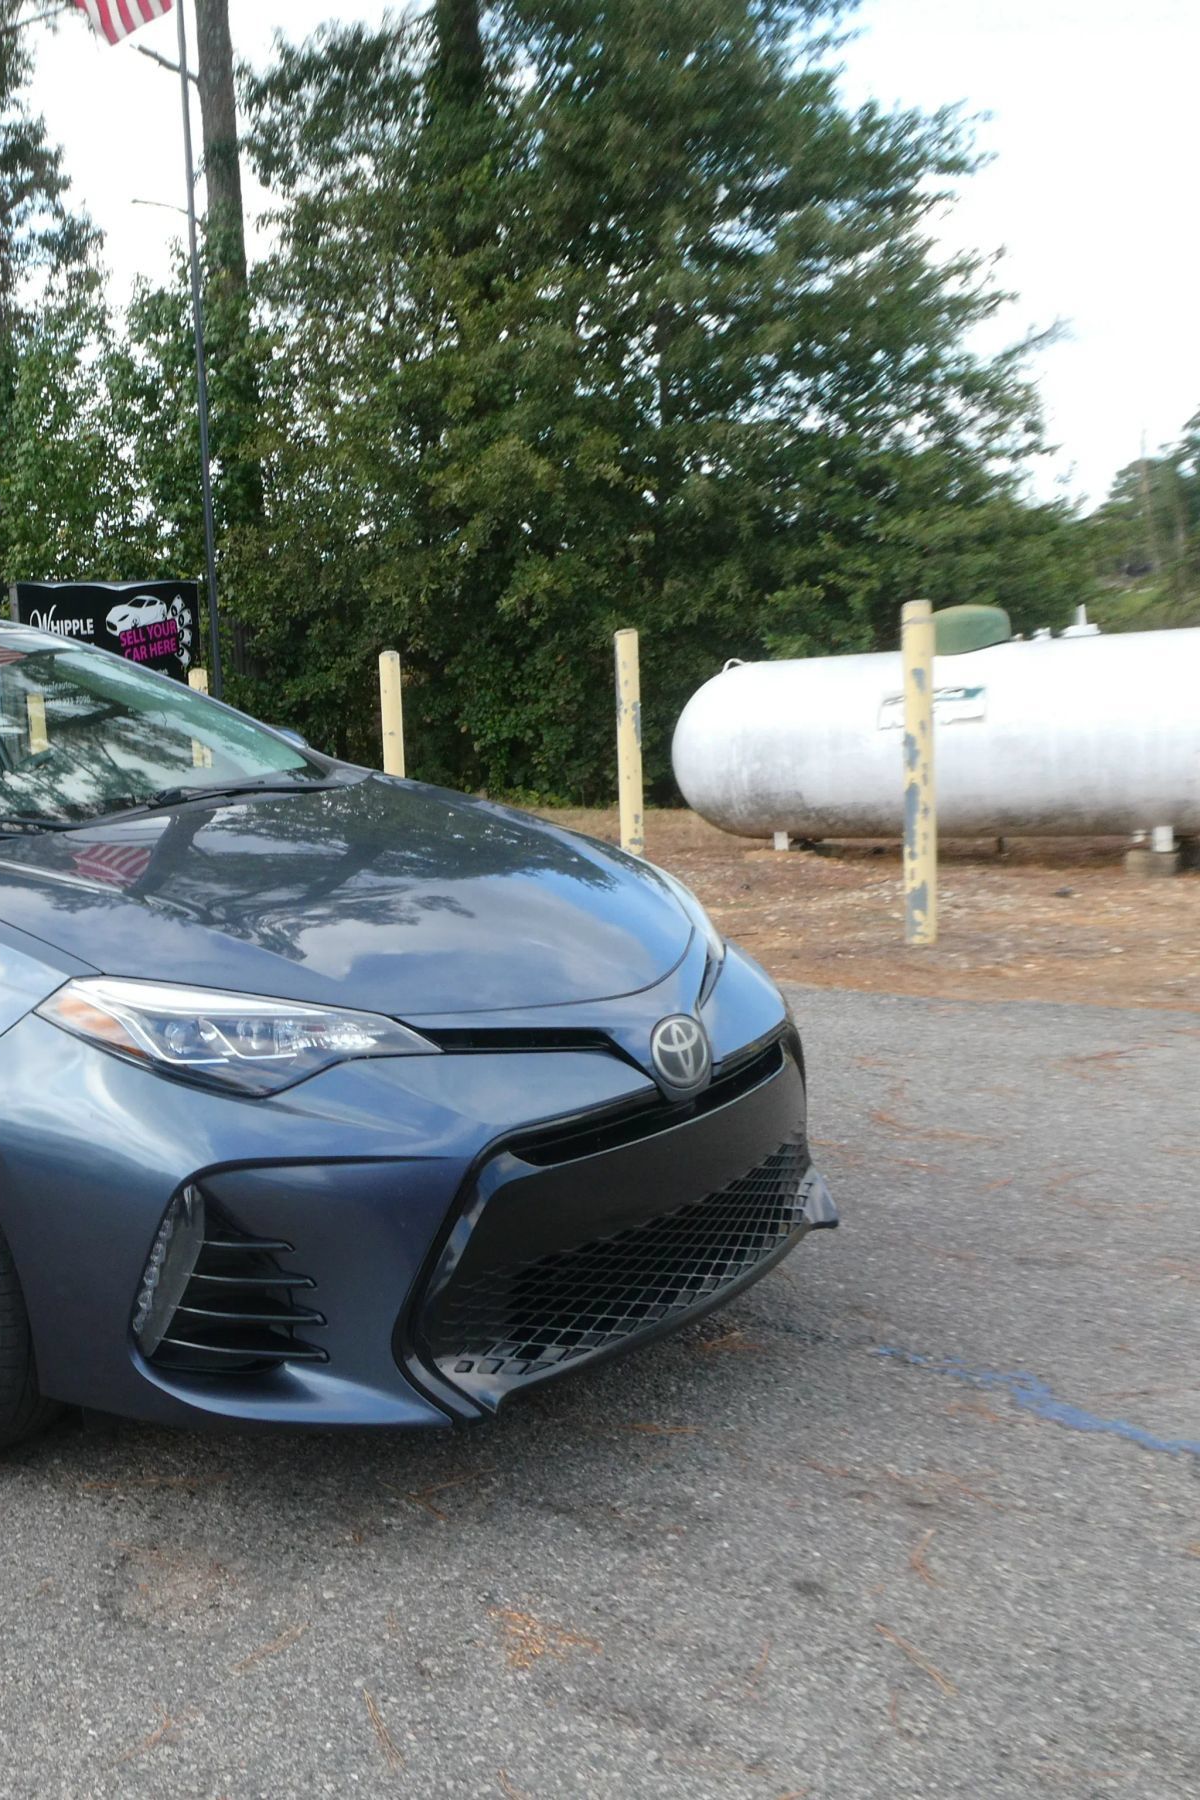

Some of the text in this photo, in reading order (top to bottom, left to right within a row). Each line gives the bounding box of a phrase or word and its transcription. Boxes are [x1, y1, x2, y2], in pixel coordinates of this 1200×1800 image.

[29, 604, 95, 636] WHIPPLE
[119, 619, 177, 647] SELL YOUR
[124, 637, 177, 661] CAR HERE
